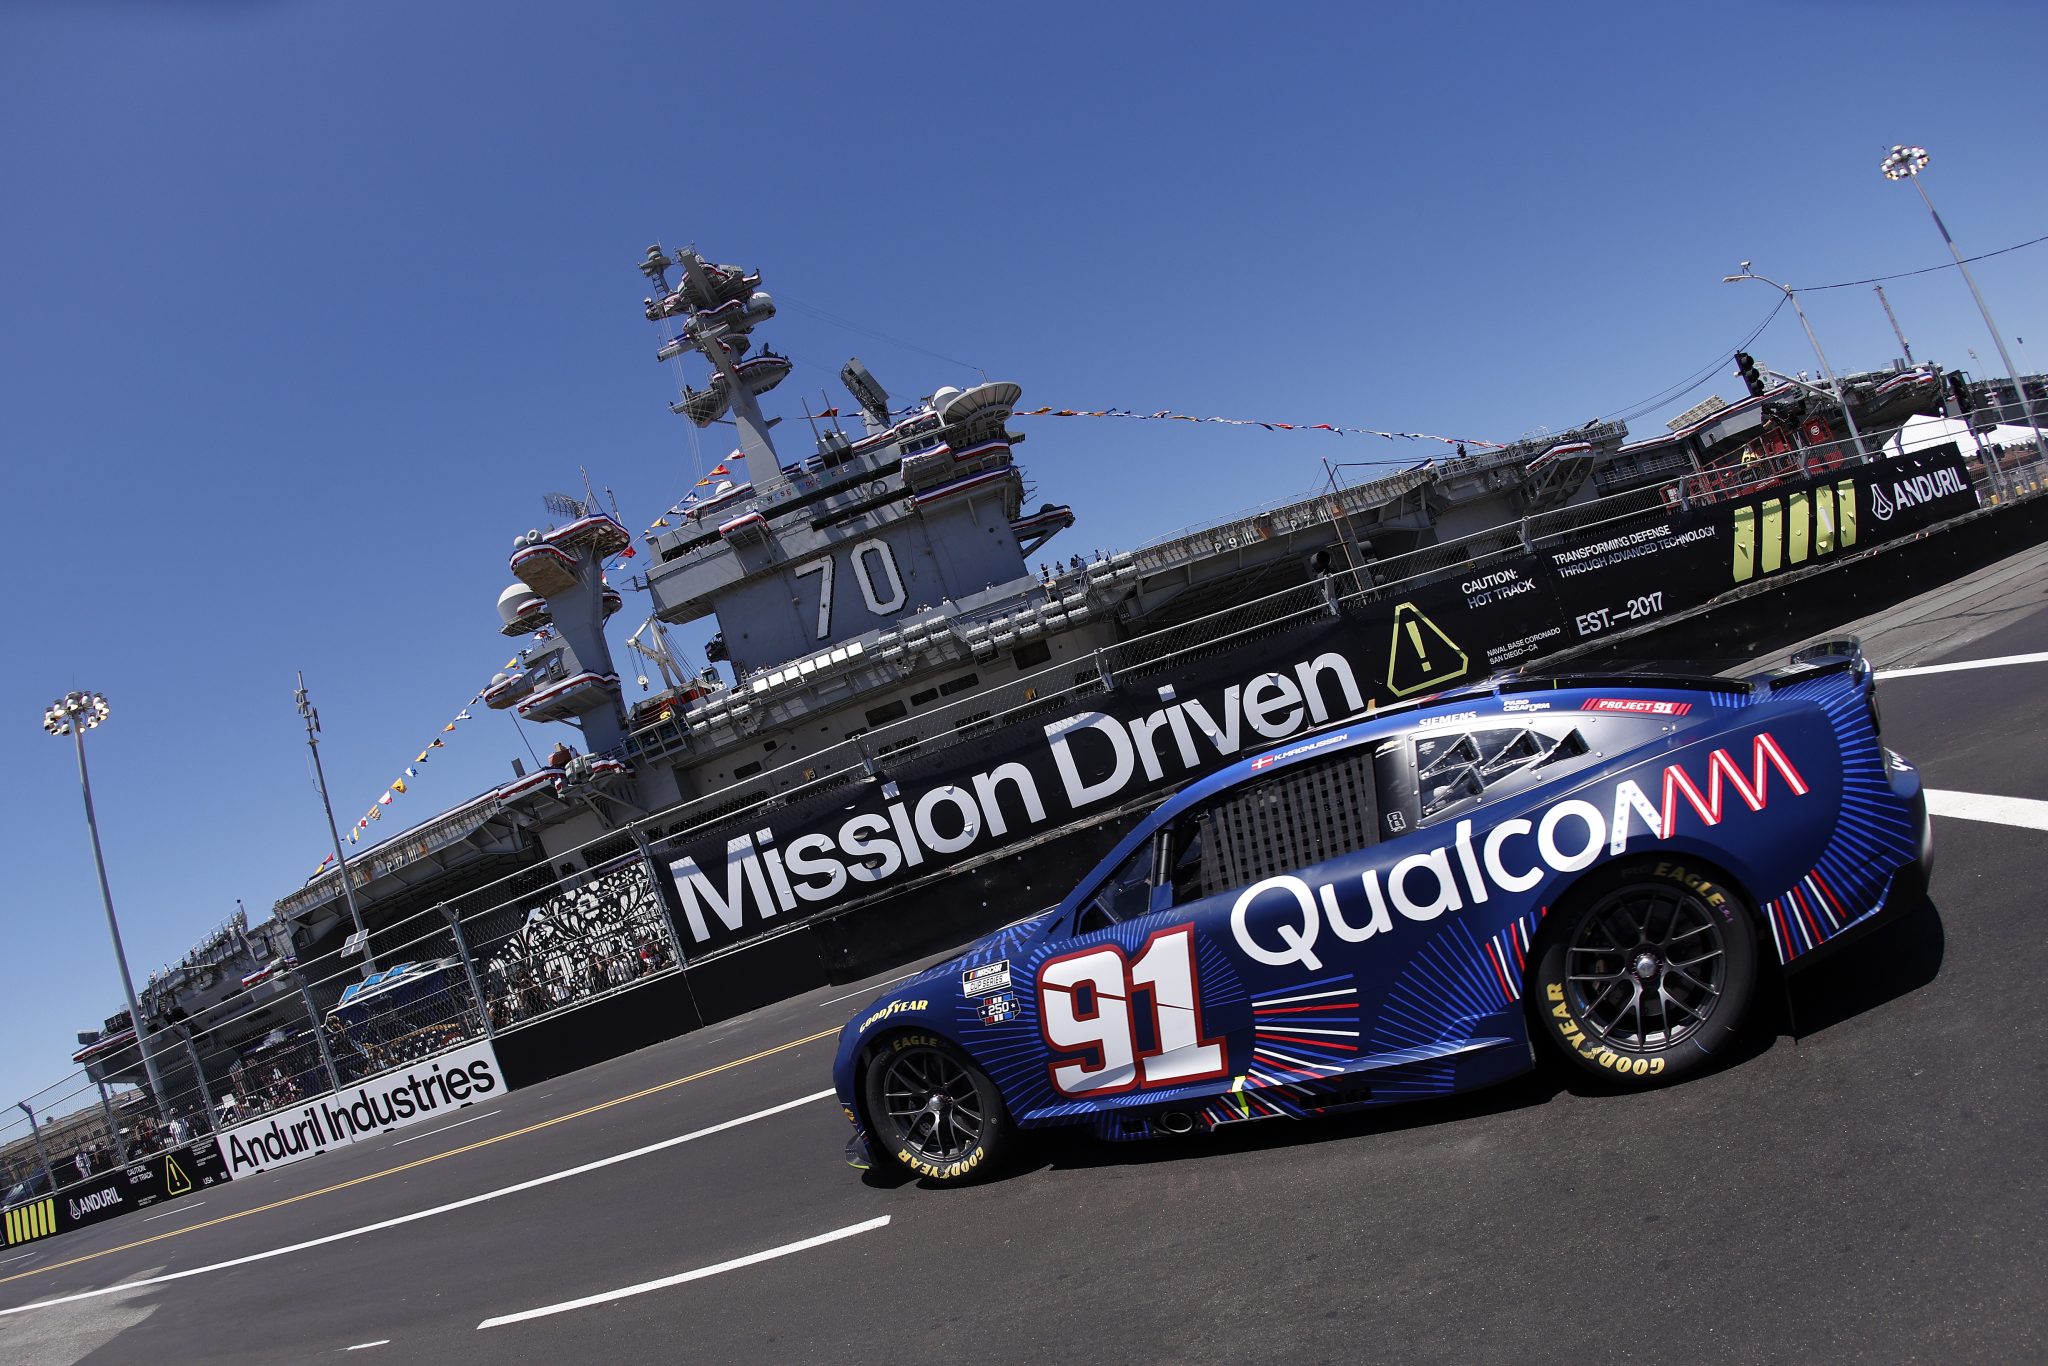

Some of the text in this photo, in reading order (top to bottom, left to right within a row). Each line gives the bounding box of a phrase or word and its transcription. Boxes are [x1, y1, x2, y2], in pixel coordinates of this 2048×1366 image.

[1894, 465, 1967, 511] ANDURIL
[1552, 524, 1671, 565] TRANSFORMING DEFENSE
[1557, 525, 1716, 578] THROUGH ADVANCED TECHNOLOGY
[794, 538, 910, 640] 70
[1461, 568, 1519, 594] CAUTION:
[1466, 577, 1537, 609] HOT TRACK
[1486, 627, 1561, 657] NAVAL BASE CORONADO
[1489, 656, 1504, 665] SAN
[1418, 711, 1477, 728] SIEMENS
[1598, 700, 1674, 714] PROJECT 91
[669, 652, 1365, 944] Mission Driven
[1654, 862, 1726, 907] EAGLE
[970, 975, 1003, 991] CUP SERIES
[859, 1000, 929, 1034] GOODYEAR
[988, 1002, 1010, 1016] 250
[1037, 922, 1229, 1099] 91
[892, 1035, 940, 1052] EAGLE
[1546, 982, 1665, 1076] GOODYEAR
[229, 1059, 496, 1173] Anduril Industries
[898, 1145, 985, 1180] GOODYEAR
[80, 1187, 123, 1214] ANDURIL
